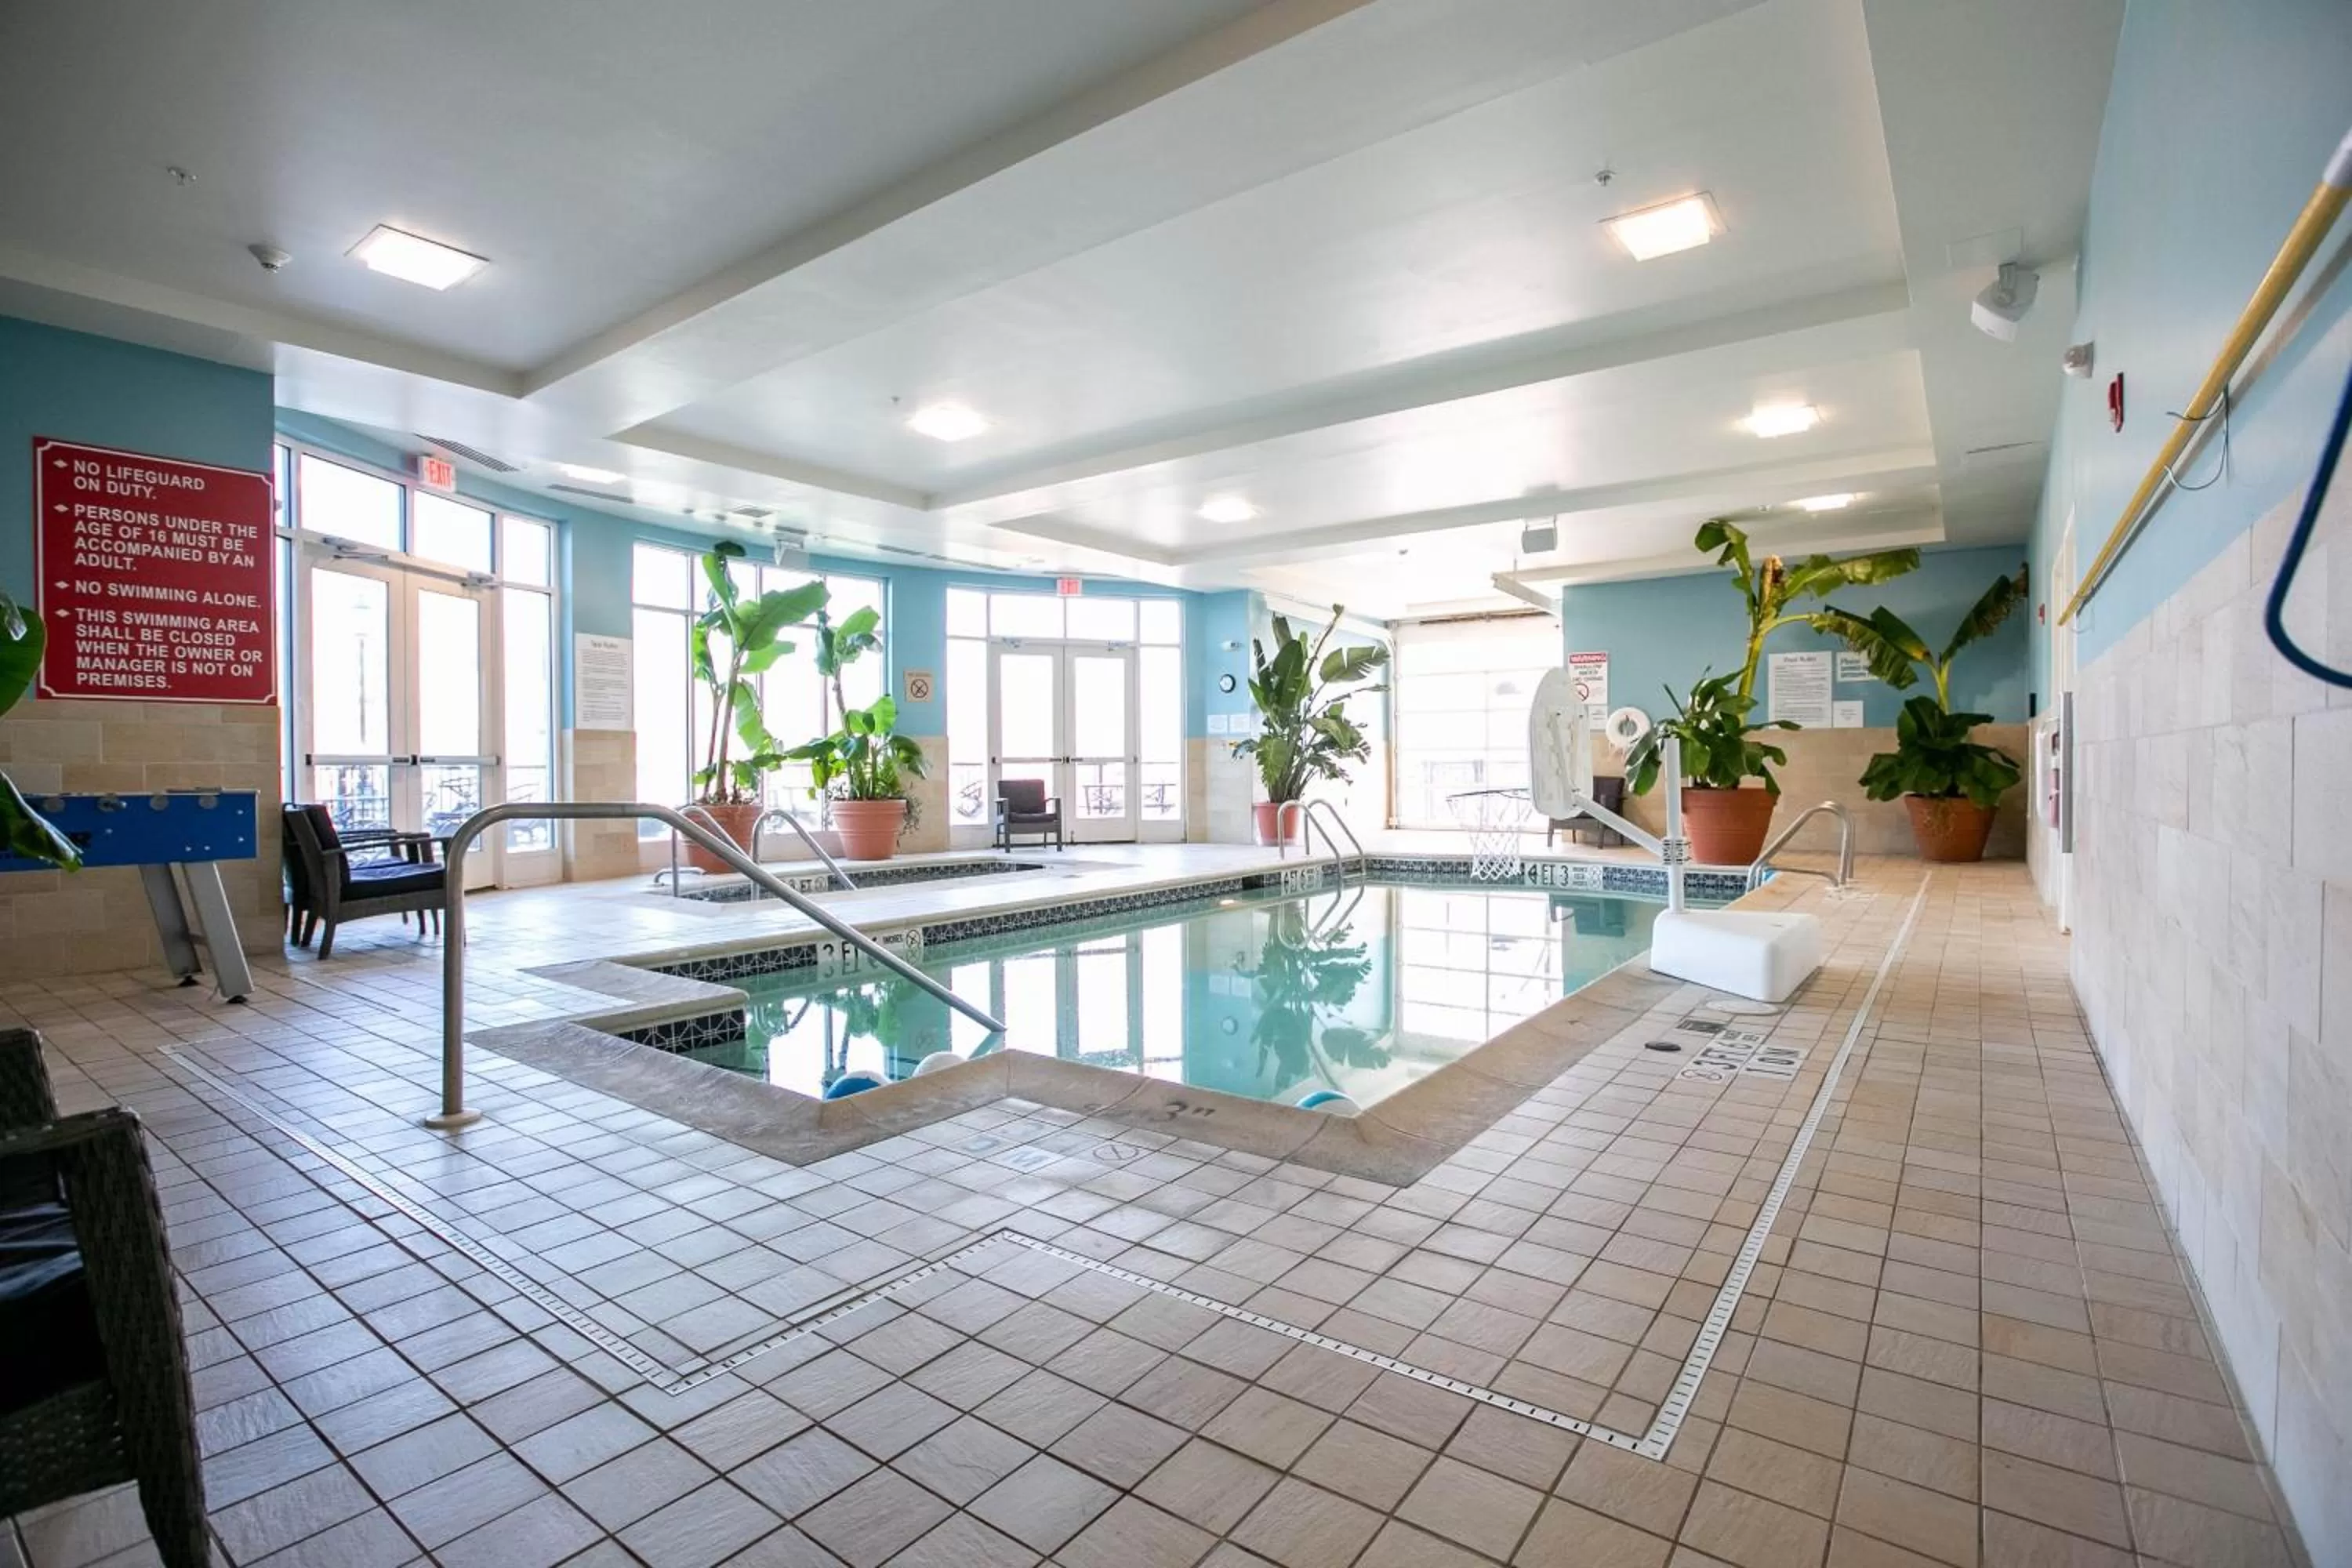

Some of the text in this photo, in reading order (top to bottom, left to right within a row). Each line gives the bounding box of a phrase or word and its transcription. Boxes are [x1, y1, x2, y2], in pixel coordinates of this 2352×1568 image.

[74, 459, 205, 491] NO LIFEGUARD
[428, 459, 452, 487] EXIT
[74, 476, 157, 499] ON DUTY.
[74, 503, 258, 539] PERSONS UNDER THE
[74, 521, 245, 551] AGE OF 16 MUST BE
[74, 536, 255, 568] ACCOMPANIED BY AN
[74, 553, 138, 571] ADULT.
[75, 580, 262, 608] NO SWIMMING ALONE.
[75, 608, 260, 633] THIS SWIMMING AREA
[76, 624, 236, 647] SHALL BE CLOSED
[76, 640, 263, 662] WHEN THE OWNER OR
[76, 657, 253, 677] MANAGER IS NOT ON
[76, 673, 172, 689] PREMISES.
